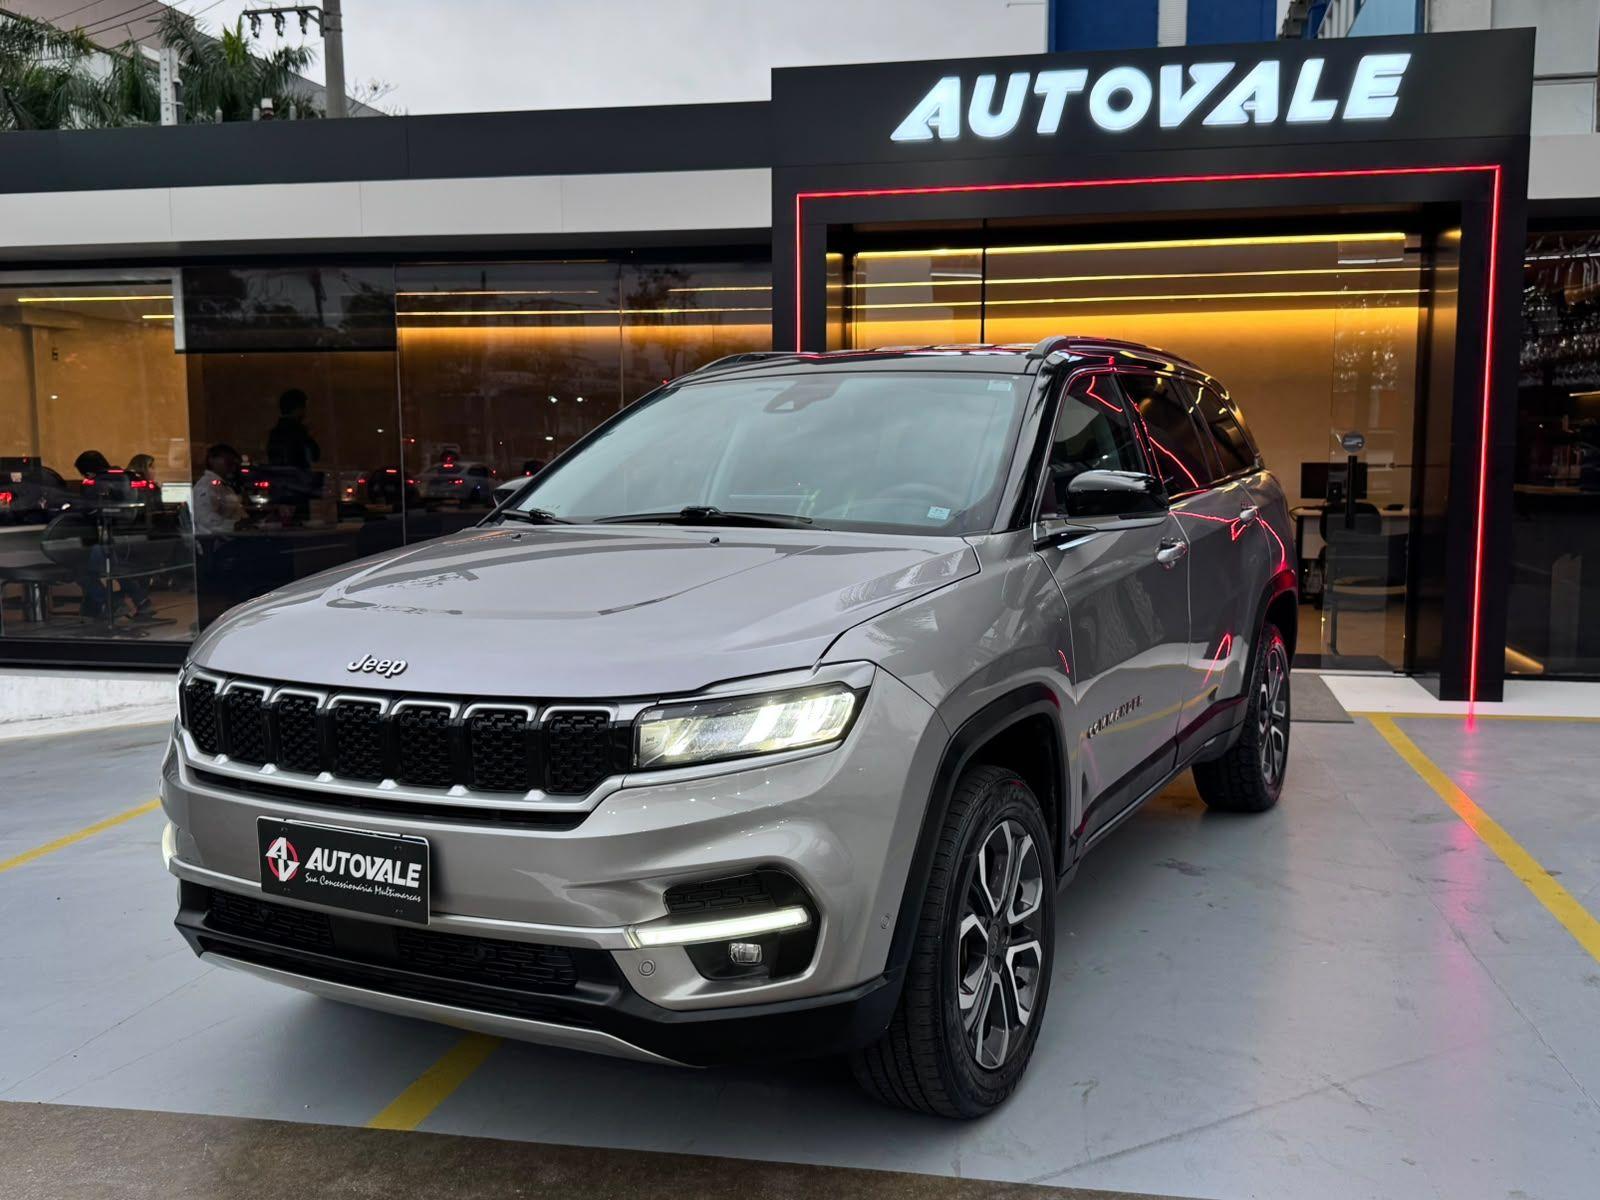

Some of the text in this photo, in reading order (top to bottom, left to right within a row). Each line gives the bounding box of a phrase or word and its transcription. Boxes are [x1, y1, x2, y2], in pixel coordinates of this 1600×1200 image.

[890, 52, 1412, 142] AUTOVALE
[347, 653, 408, 679] Jeep
[304, 847, 422, 889] AUTOVALE
[305, 872, 318, 883] Sua
